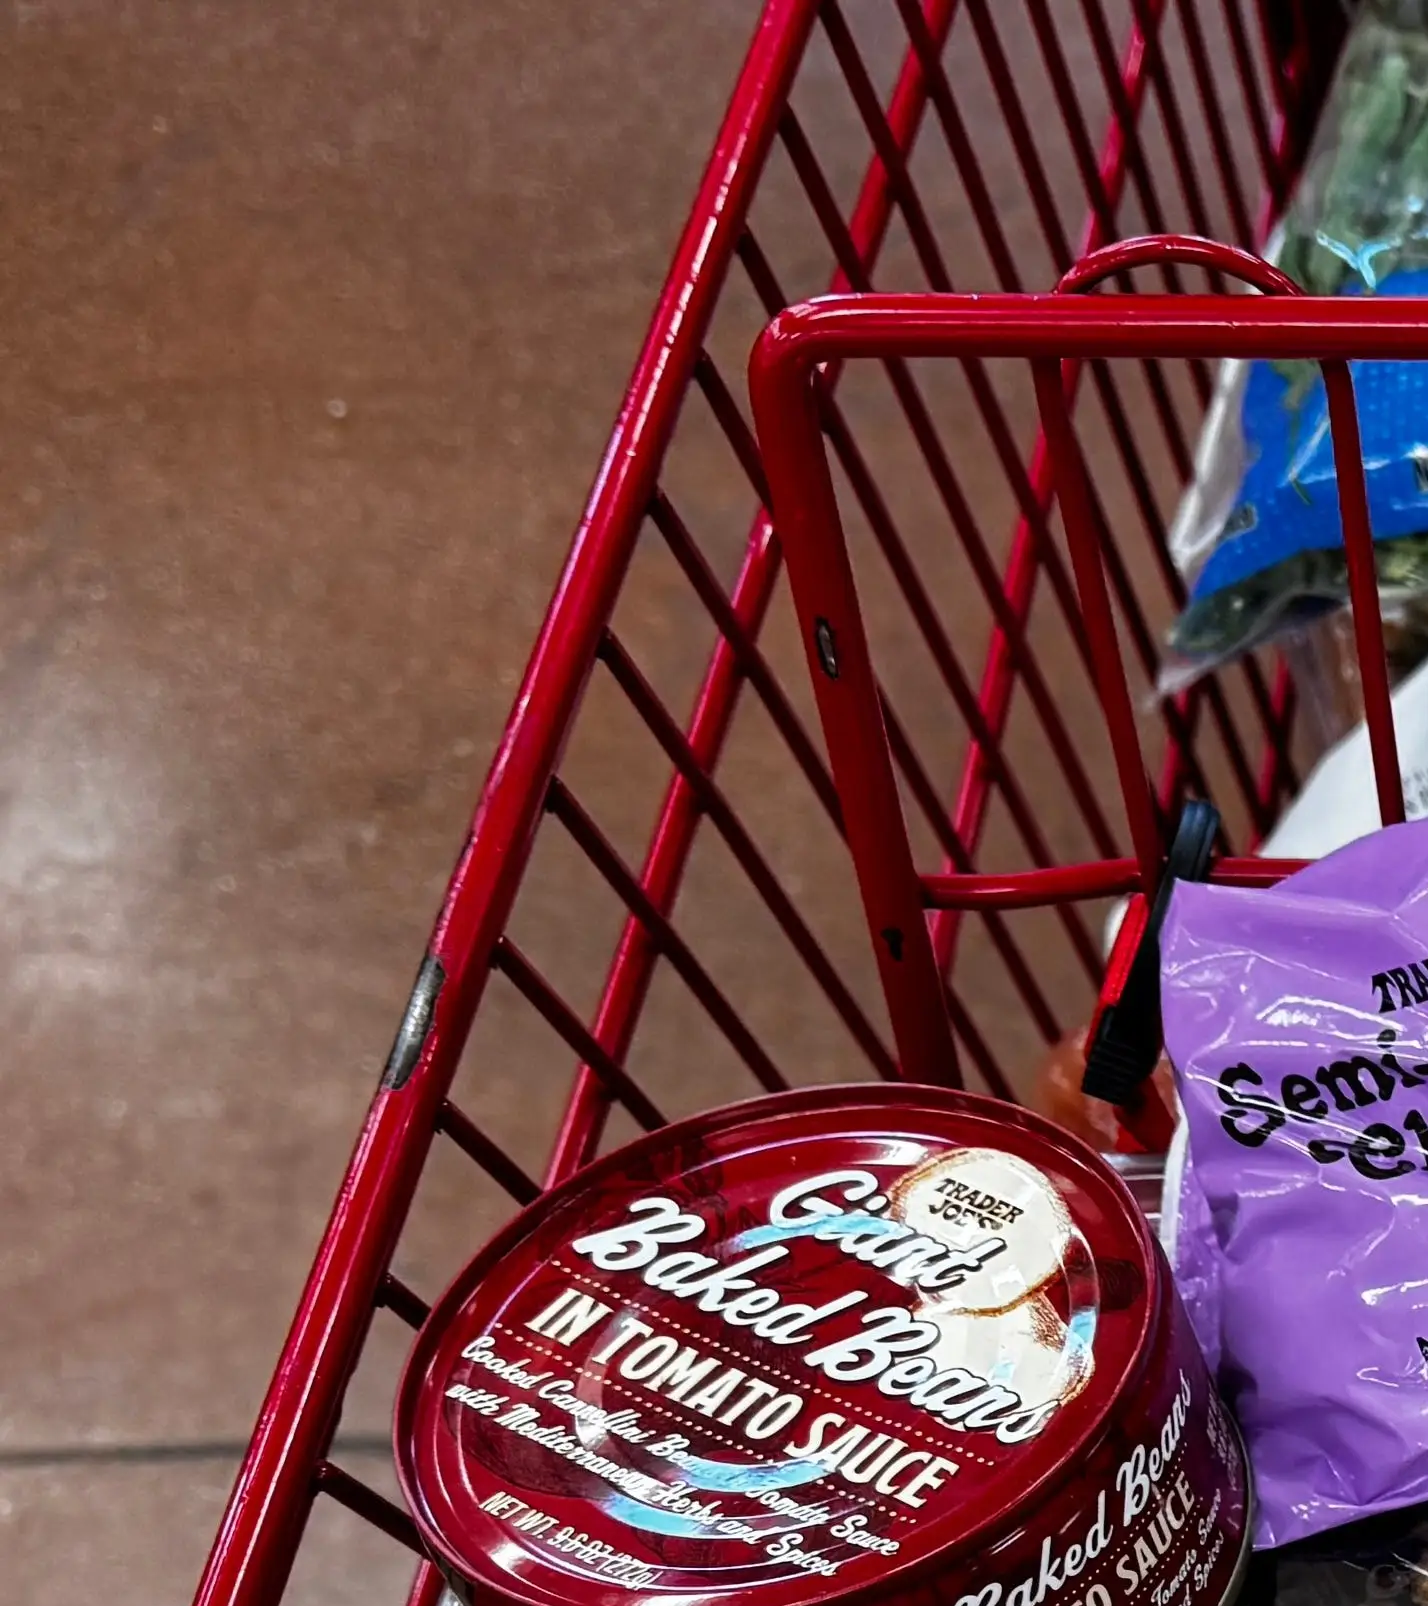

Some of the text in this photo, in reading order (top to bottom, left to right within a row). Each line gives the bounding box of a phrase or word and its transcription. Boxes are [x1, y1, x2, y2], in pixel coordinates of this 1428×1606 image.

[768, 1170, 1004, 1292] Giant
[934, 1178, 1024, 1224] TRADER
[573, 1197, 868, 1345] Baked
[803, 1306, 1060, 1445] Beans
[461, 1336, 554, 1390] Cooked
[538, 1379, 654, 1444] Cannellini
[524, 1288, 960, 1510] IN TOMATO SAUCE
[1116, 1368, 1191, 1527] Beans
[445, 1384, 510, 1416] with
[652, 1480, 724, 1526] Herbs
[715, 1518, 763, 1545] and
[766, 1532, 838, 1577] Spices
[479, 1491, 529, 1520] NET
[512, 1509, 560, 1539] WT.
[830, 1514, 901, 1557] Sauce
[1116, 1471, 1195, 1596] SAUCE
